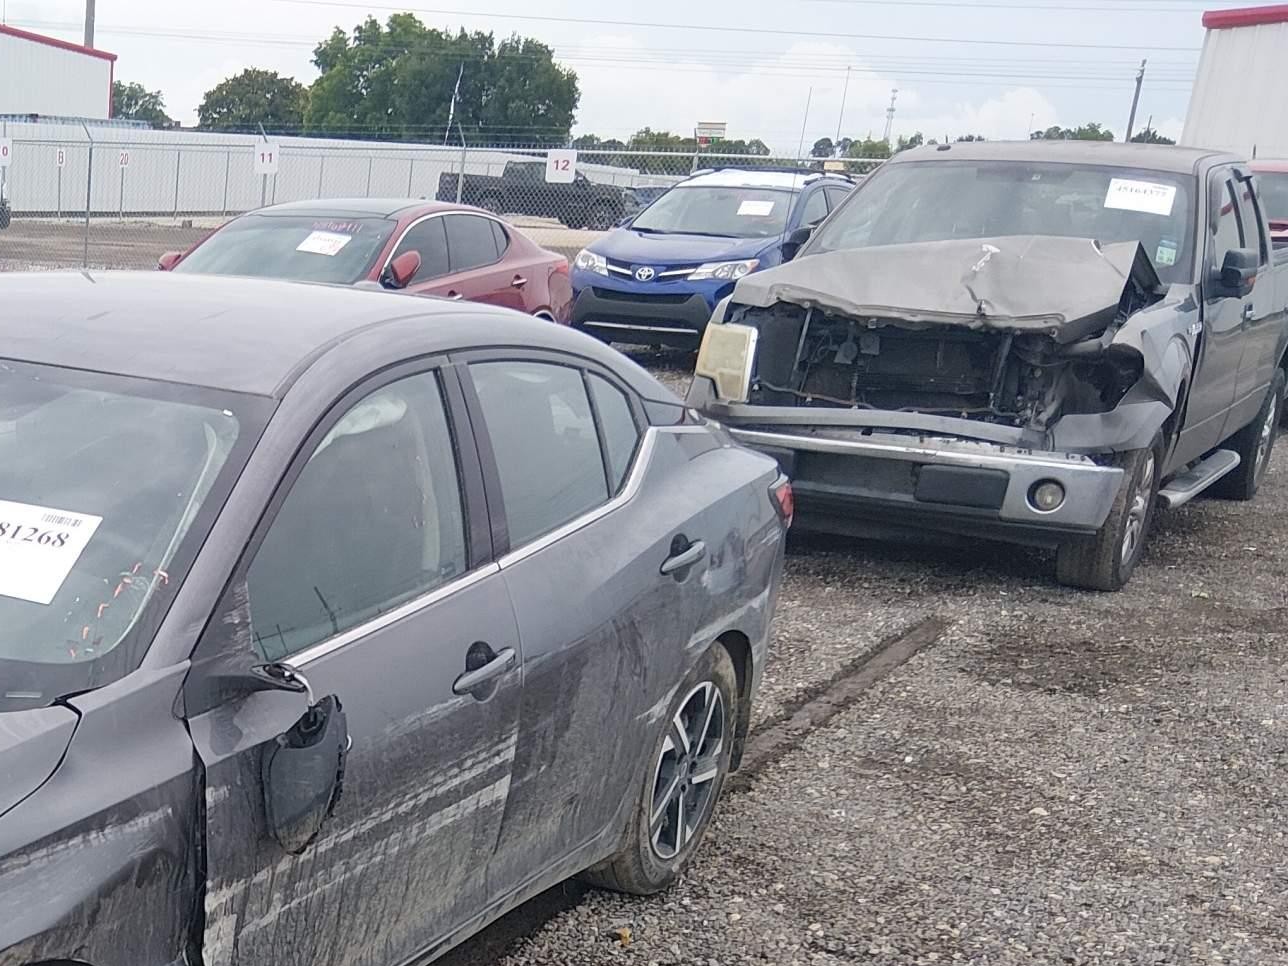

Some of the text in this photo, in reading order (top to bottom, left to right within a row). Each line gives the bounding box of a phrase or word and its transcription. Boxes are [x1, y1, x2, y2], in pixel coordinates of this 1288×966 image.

[120, 153, 129, 165] 20
[261, 152, 272, 163] 11
[554, 160, 570, 171] 12
